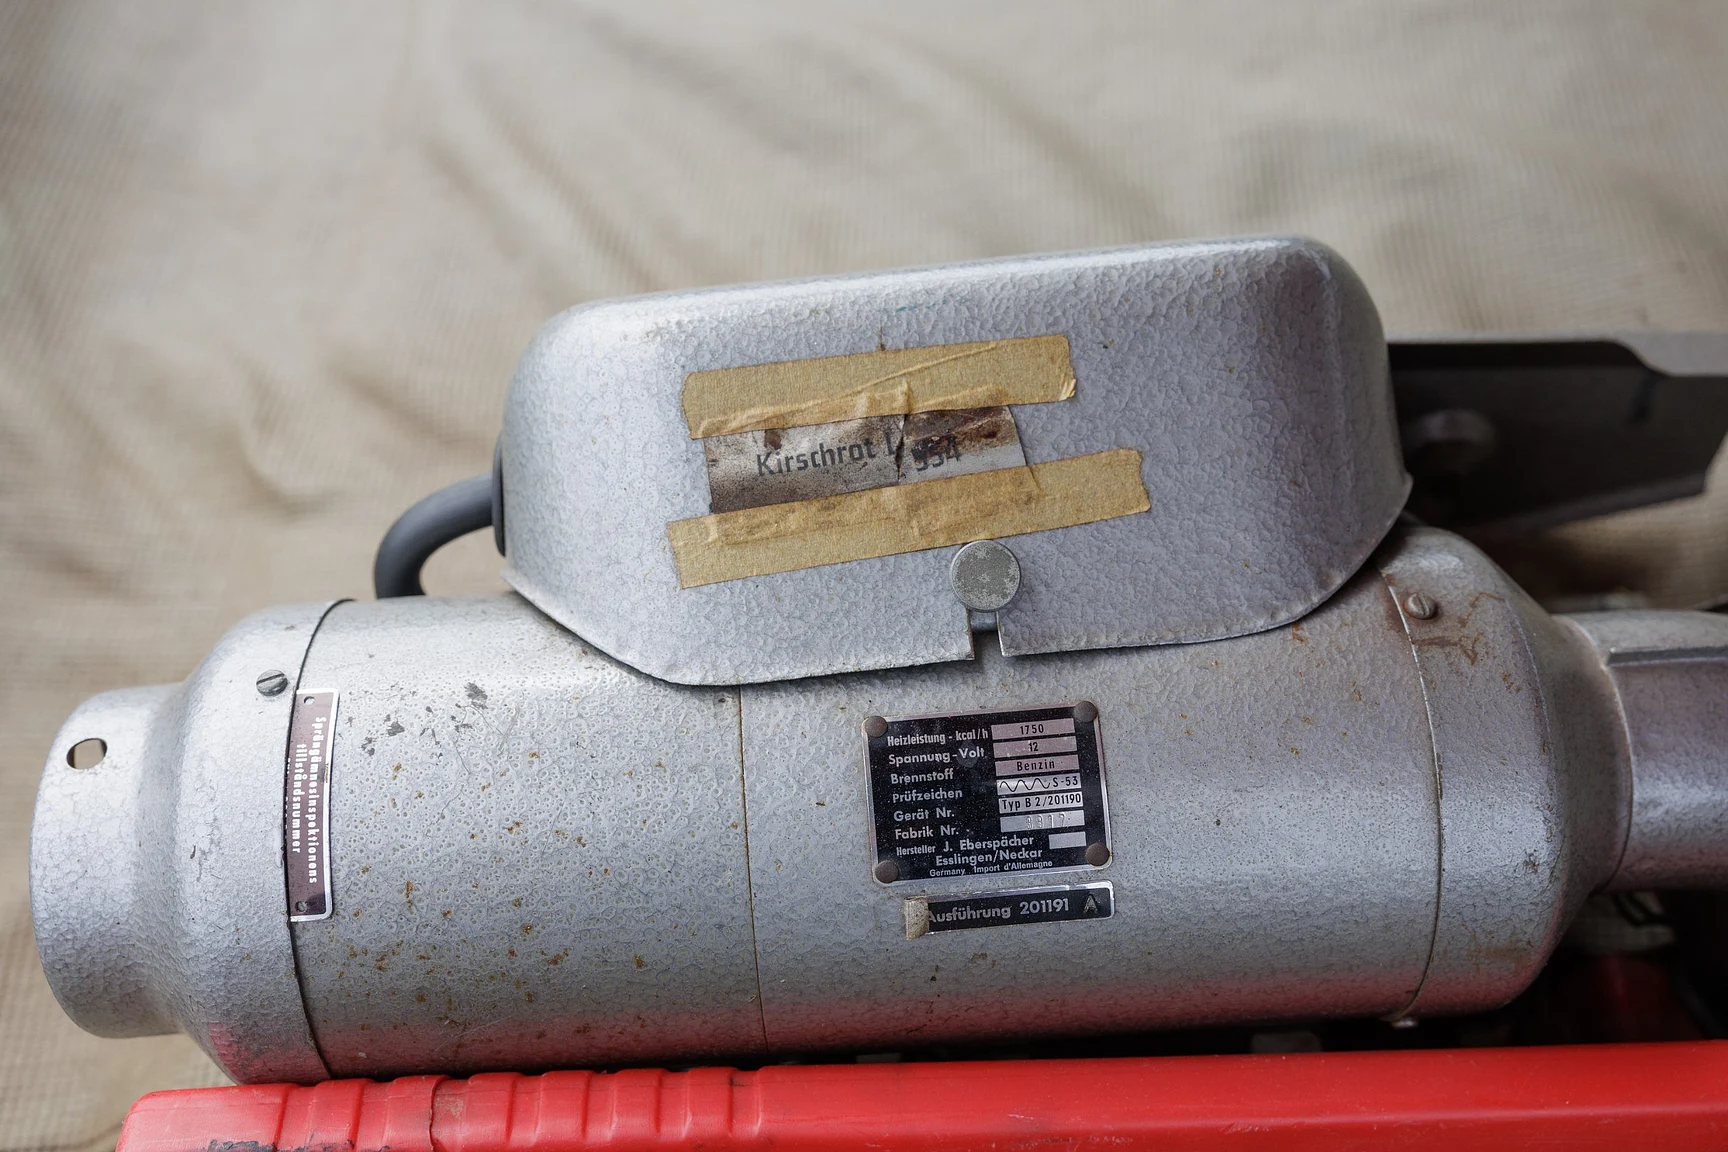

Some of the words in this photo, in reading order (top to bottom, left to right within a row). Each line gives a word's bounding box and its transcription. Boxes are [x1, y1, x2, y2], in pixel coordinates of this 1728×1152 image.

[757, 438, 875, 476] Kirschrot
[887, 733, 946, 746] Heizleistung
[1020, 724, 1044, 735] 1750
[1028, 742, 1039, 752] 12
[891, 768, 954, 784] Brennstoff
[1017, 760, 1055, 771] Benzin
[292, 743, 308, 853] tillståndsnummer
[305, 716, 327, 884] Sprängämnesinspektionens
[893, 787, 963, 803] Prüfzeichen
[894, 808, 930, 822] Gerät
[936, 807, 955, 818] Nr.
[1002, 799, 1021, 811] Typ
[895, 825, 934, 840] Fabrik
[940, 824, 959, 836] Nr.
[896, 844, 936, 856] Hersteller
[943, 841, 953, 852] J.
[960, 835, 1034, 851] Eberspächer
[929, 868, 966, 877] Germany
[973, 864, 1000, 875] Import
[1004, 860, 1053, 871] d'Allemagne
[936, 848, 1043, 867] Esslingen/Neckar
[1019, 898, 1069, 915] 201191
[1083, 893, 1098, 914] A
